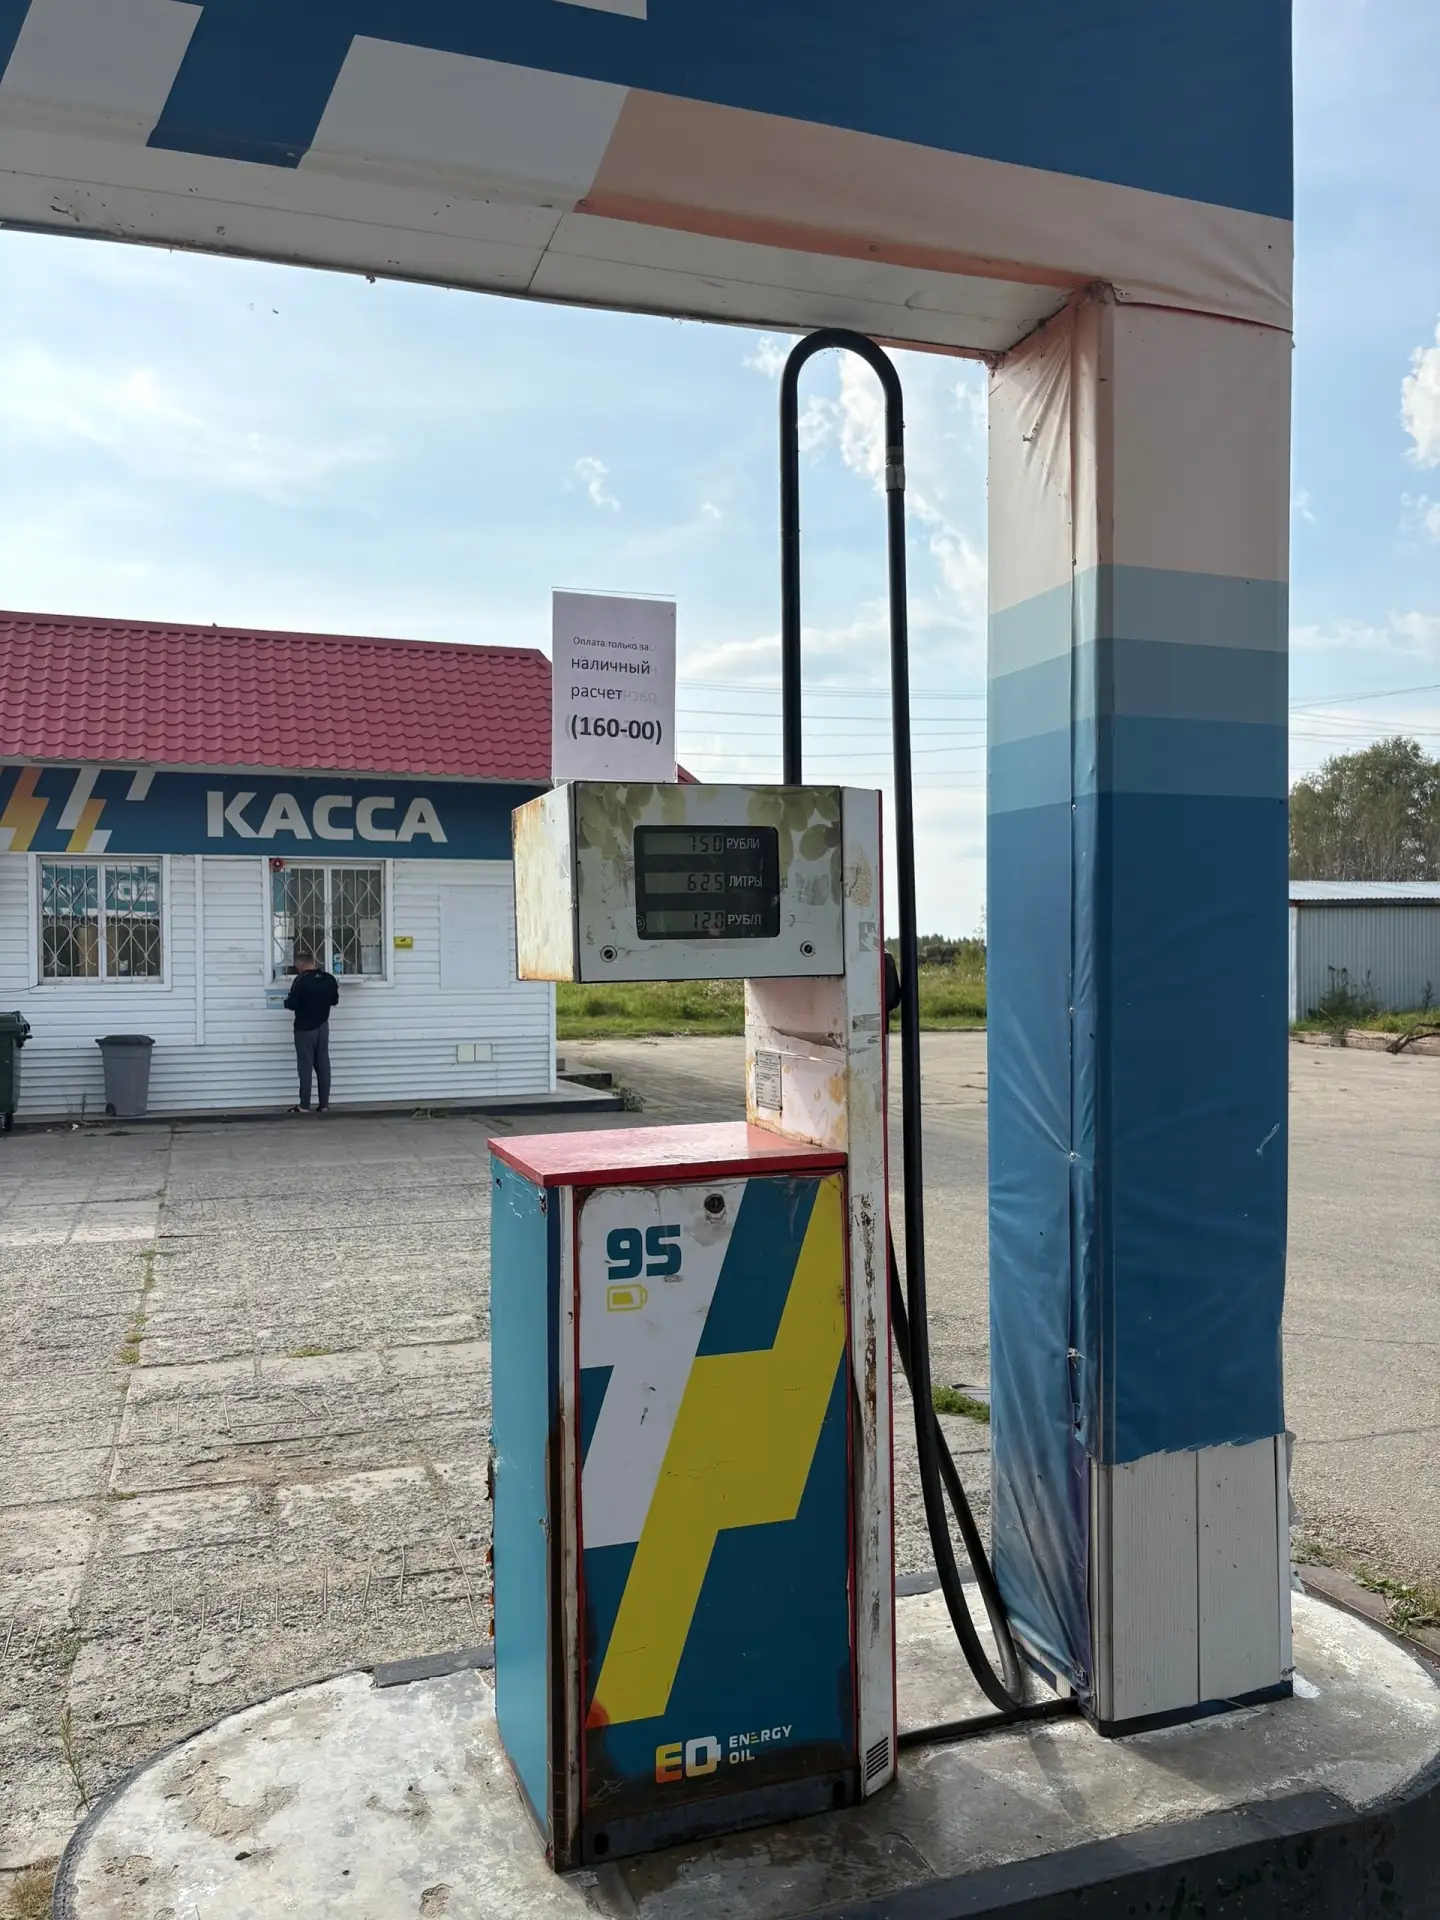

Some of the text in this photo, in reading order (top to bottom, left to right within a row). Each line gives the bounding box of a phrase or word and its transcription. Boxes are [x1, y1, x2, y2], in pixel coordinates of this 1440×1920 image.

[573, 636, 649, 652] Оплата только за
[571, 657, 650, 675] наличный
[571, 684, 623, 700] расчет
[571, 714, 662, 745] (160-00)
[206, 791, 449, 844] КАССА
[688, 834, 760, 853] 750 РУБЛИ
[687, 873, 763, 892] 625 ЛИТРЫ
[693, 911, 762, 930] 120 РУБ/Л
[606, 1224, 682, 1280] 95
[728, 1724, 793, 1749] ENERGY
[655, 1735, 722, 1784] EO
[728, 1748, 755, 1765] OIL
